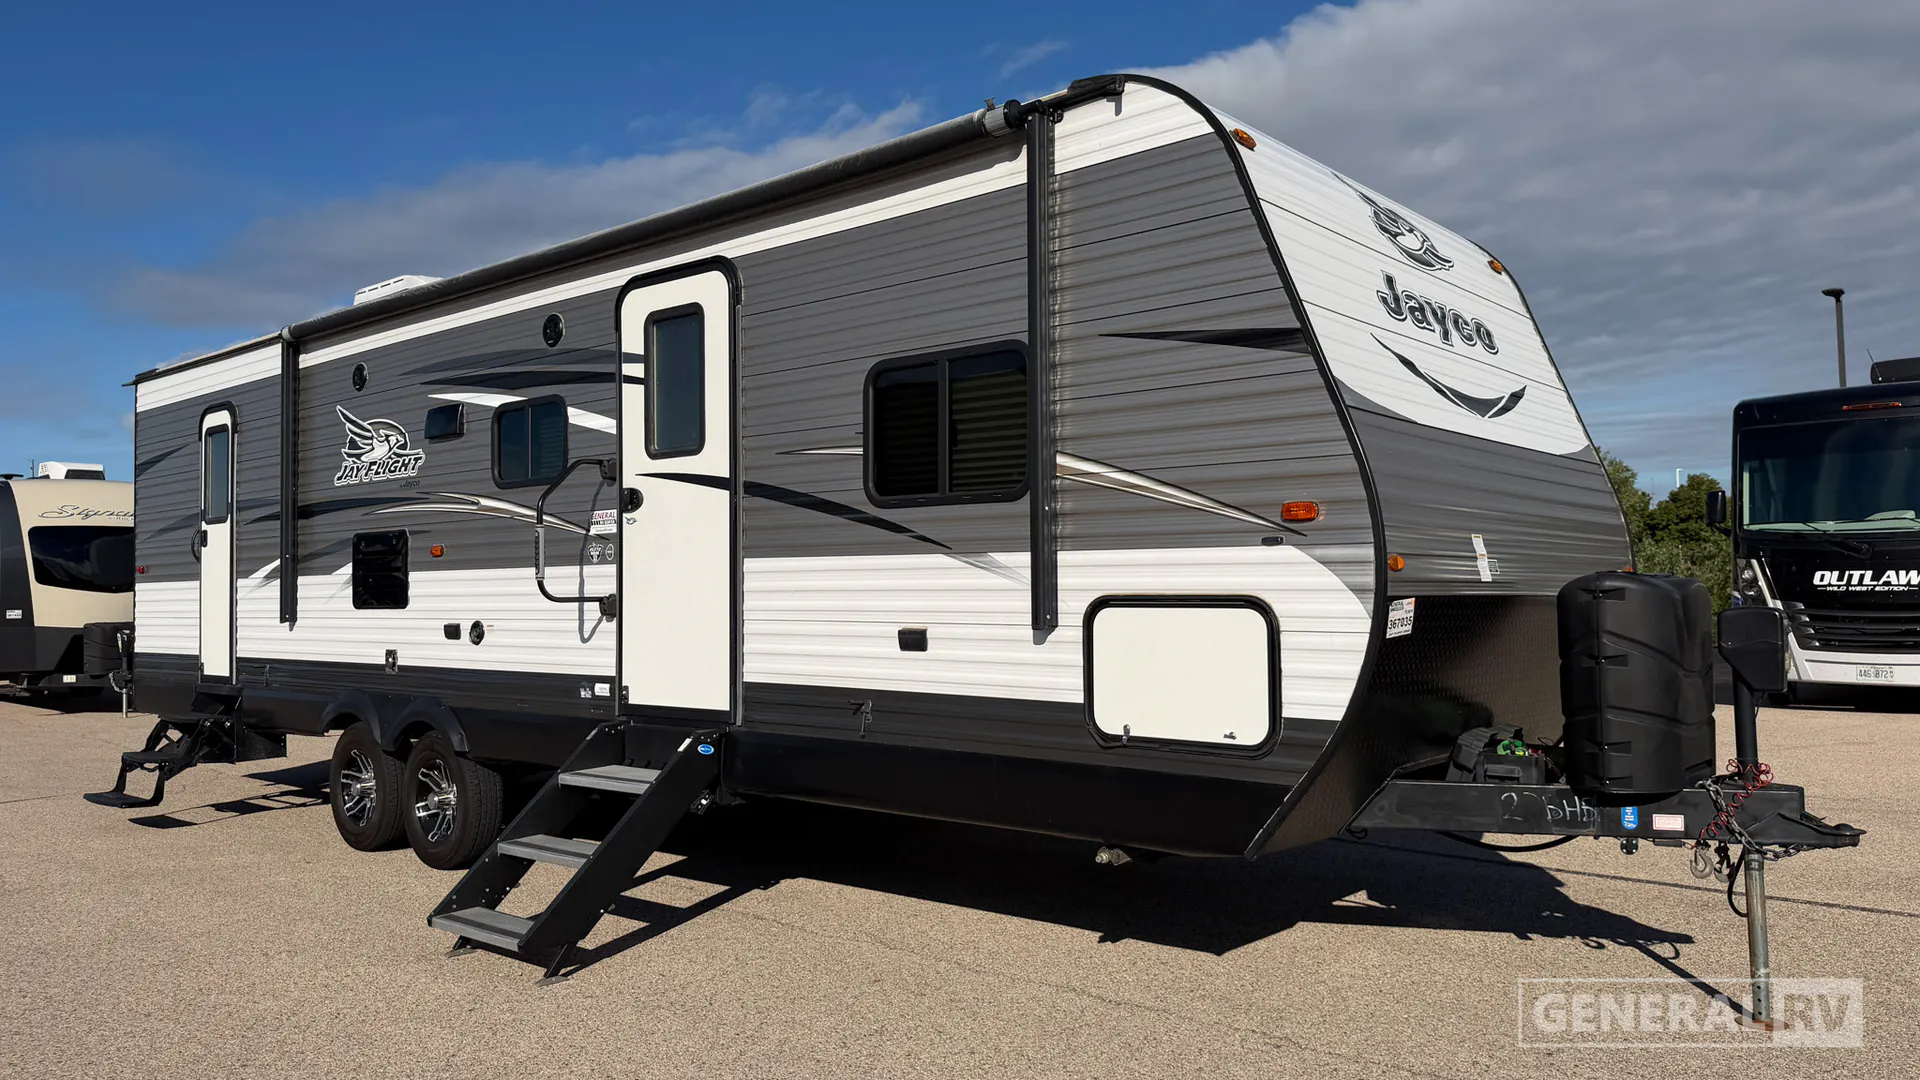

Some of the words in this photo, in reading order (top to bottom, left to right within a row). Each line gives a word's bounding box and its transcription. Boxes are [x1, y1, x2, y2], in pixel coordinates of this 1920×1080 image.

[1376, 269, 1499, 355] Jayco
[335, 462, 365, 485] JAY
[363, 456, 425, 481] FLIGHT
[1813, 570, 1920, 585] OUTLAW
